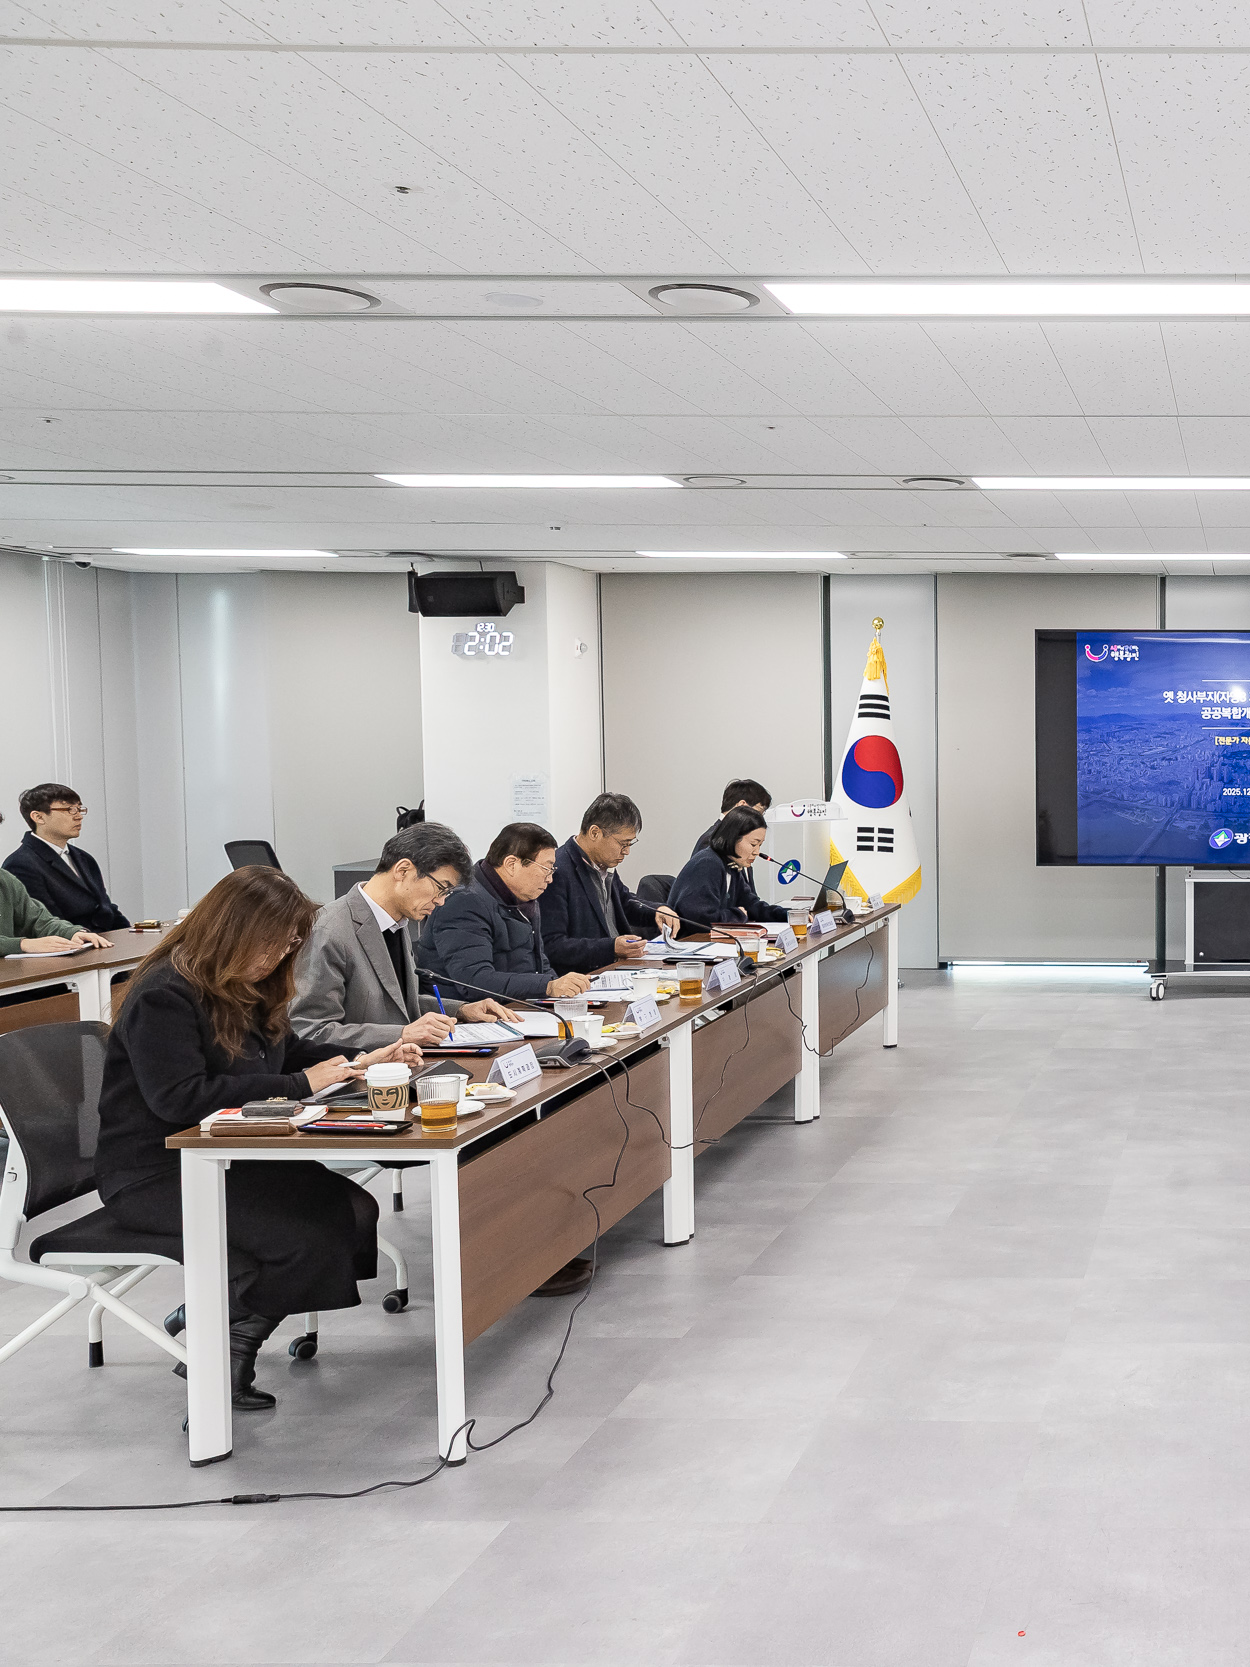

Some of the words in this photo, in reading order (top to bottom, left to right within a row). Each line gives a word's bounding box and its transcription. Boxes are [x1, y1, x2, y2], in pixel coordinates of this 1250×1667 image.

[464, 631, 513, 655] 2:02
[1163, 691, 1174, 703] 옛
[1215, 736, 1240, 745] [전문가
